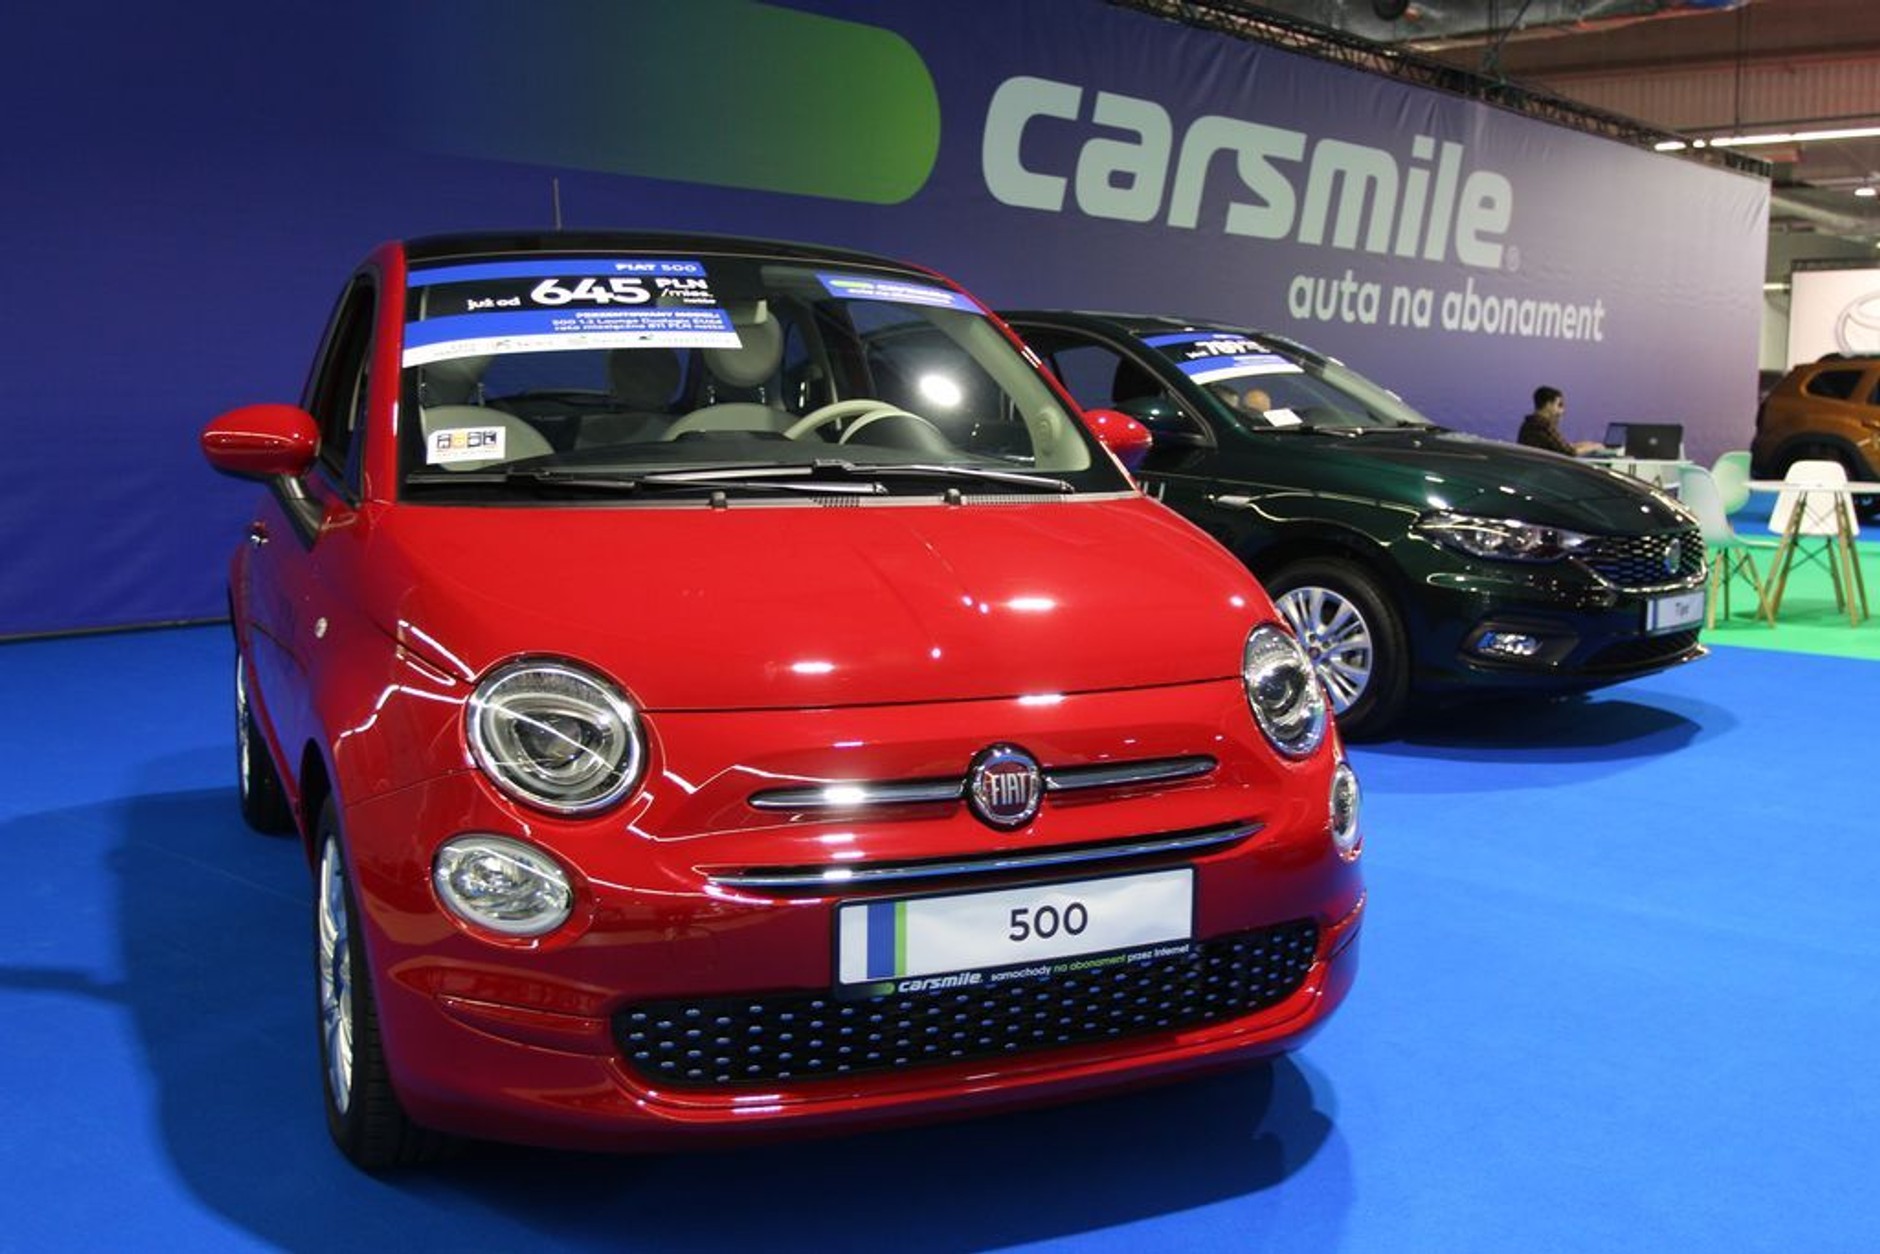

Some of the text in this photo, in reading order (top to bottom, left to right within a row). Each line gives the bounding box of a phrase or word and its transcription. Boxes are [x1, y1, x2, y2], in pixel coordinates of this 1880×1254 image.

[982, 76, 1515, 270] carsmile
[661, 263, 697, 273] 500
[496, 296, 521, 308] od
[530, 277, 652, 306] 645
[656, 278, 708, 290] PLN
[1287, 269, 1606, 343] auta na abonament
[990, 771, 1030, 806] FIAT
[1008, 901, 1089, 941] 500
[898, 971, 982, 994] carsmile
[991, 964, 1052, 982] samochody
[1054, 963, 1069, 974] na
